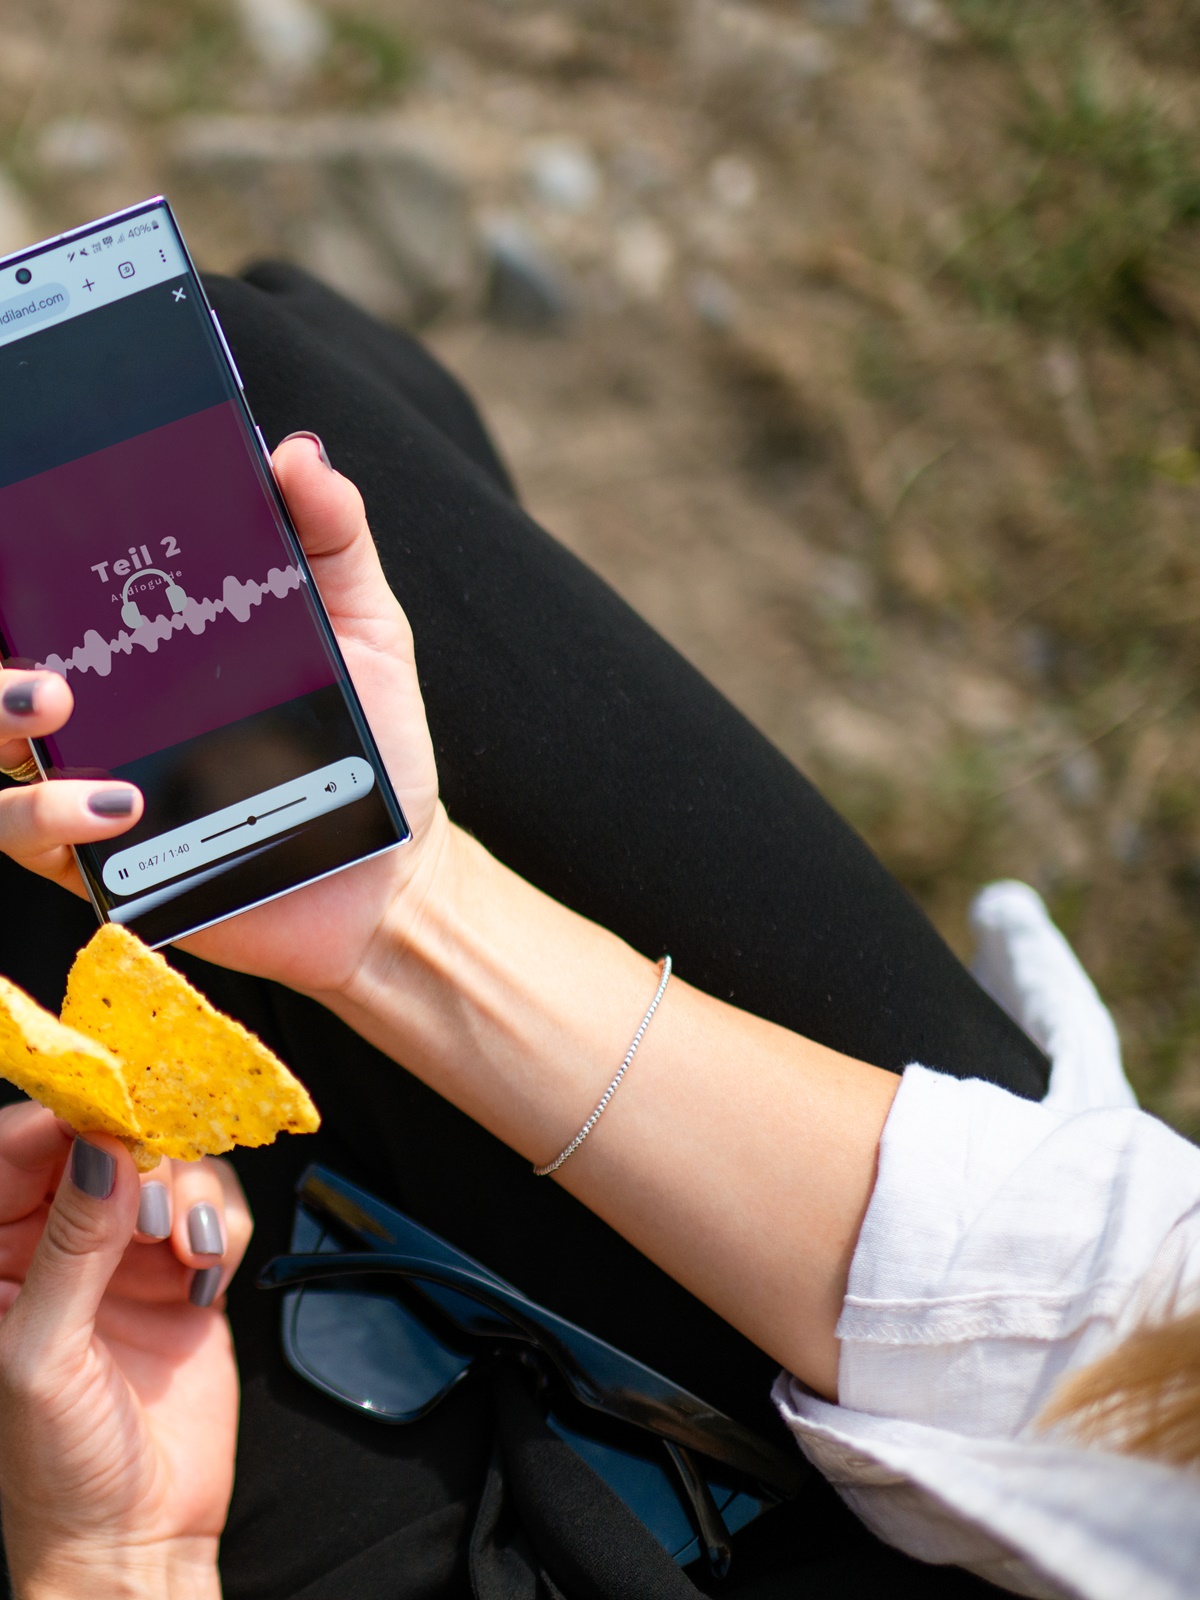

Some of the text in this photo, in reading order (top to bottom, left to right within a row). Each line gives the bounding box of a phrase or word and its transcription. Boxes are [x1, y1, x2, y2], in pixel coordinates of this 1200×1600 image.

[127, 223, 152, 239] 40%
[90, 535, 182, 583] Teil 2
[138, 855, 159, 871] 0:47
[168, 843, 190, 858] 1:40
